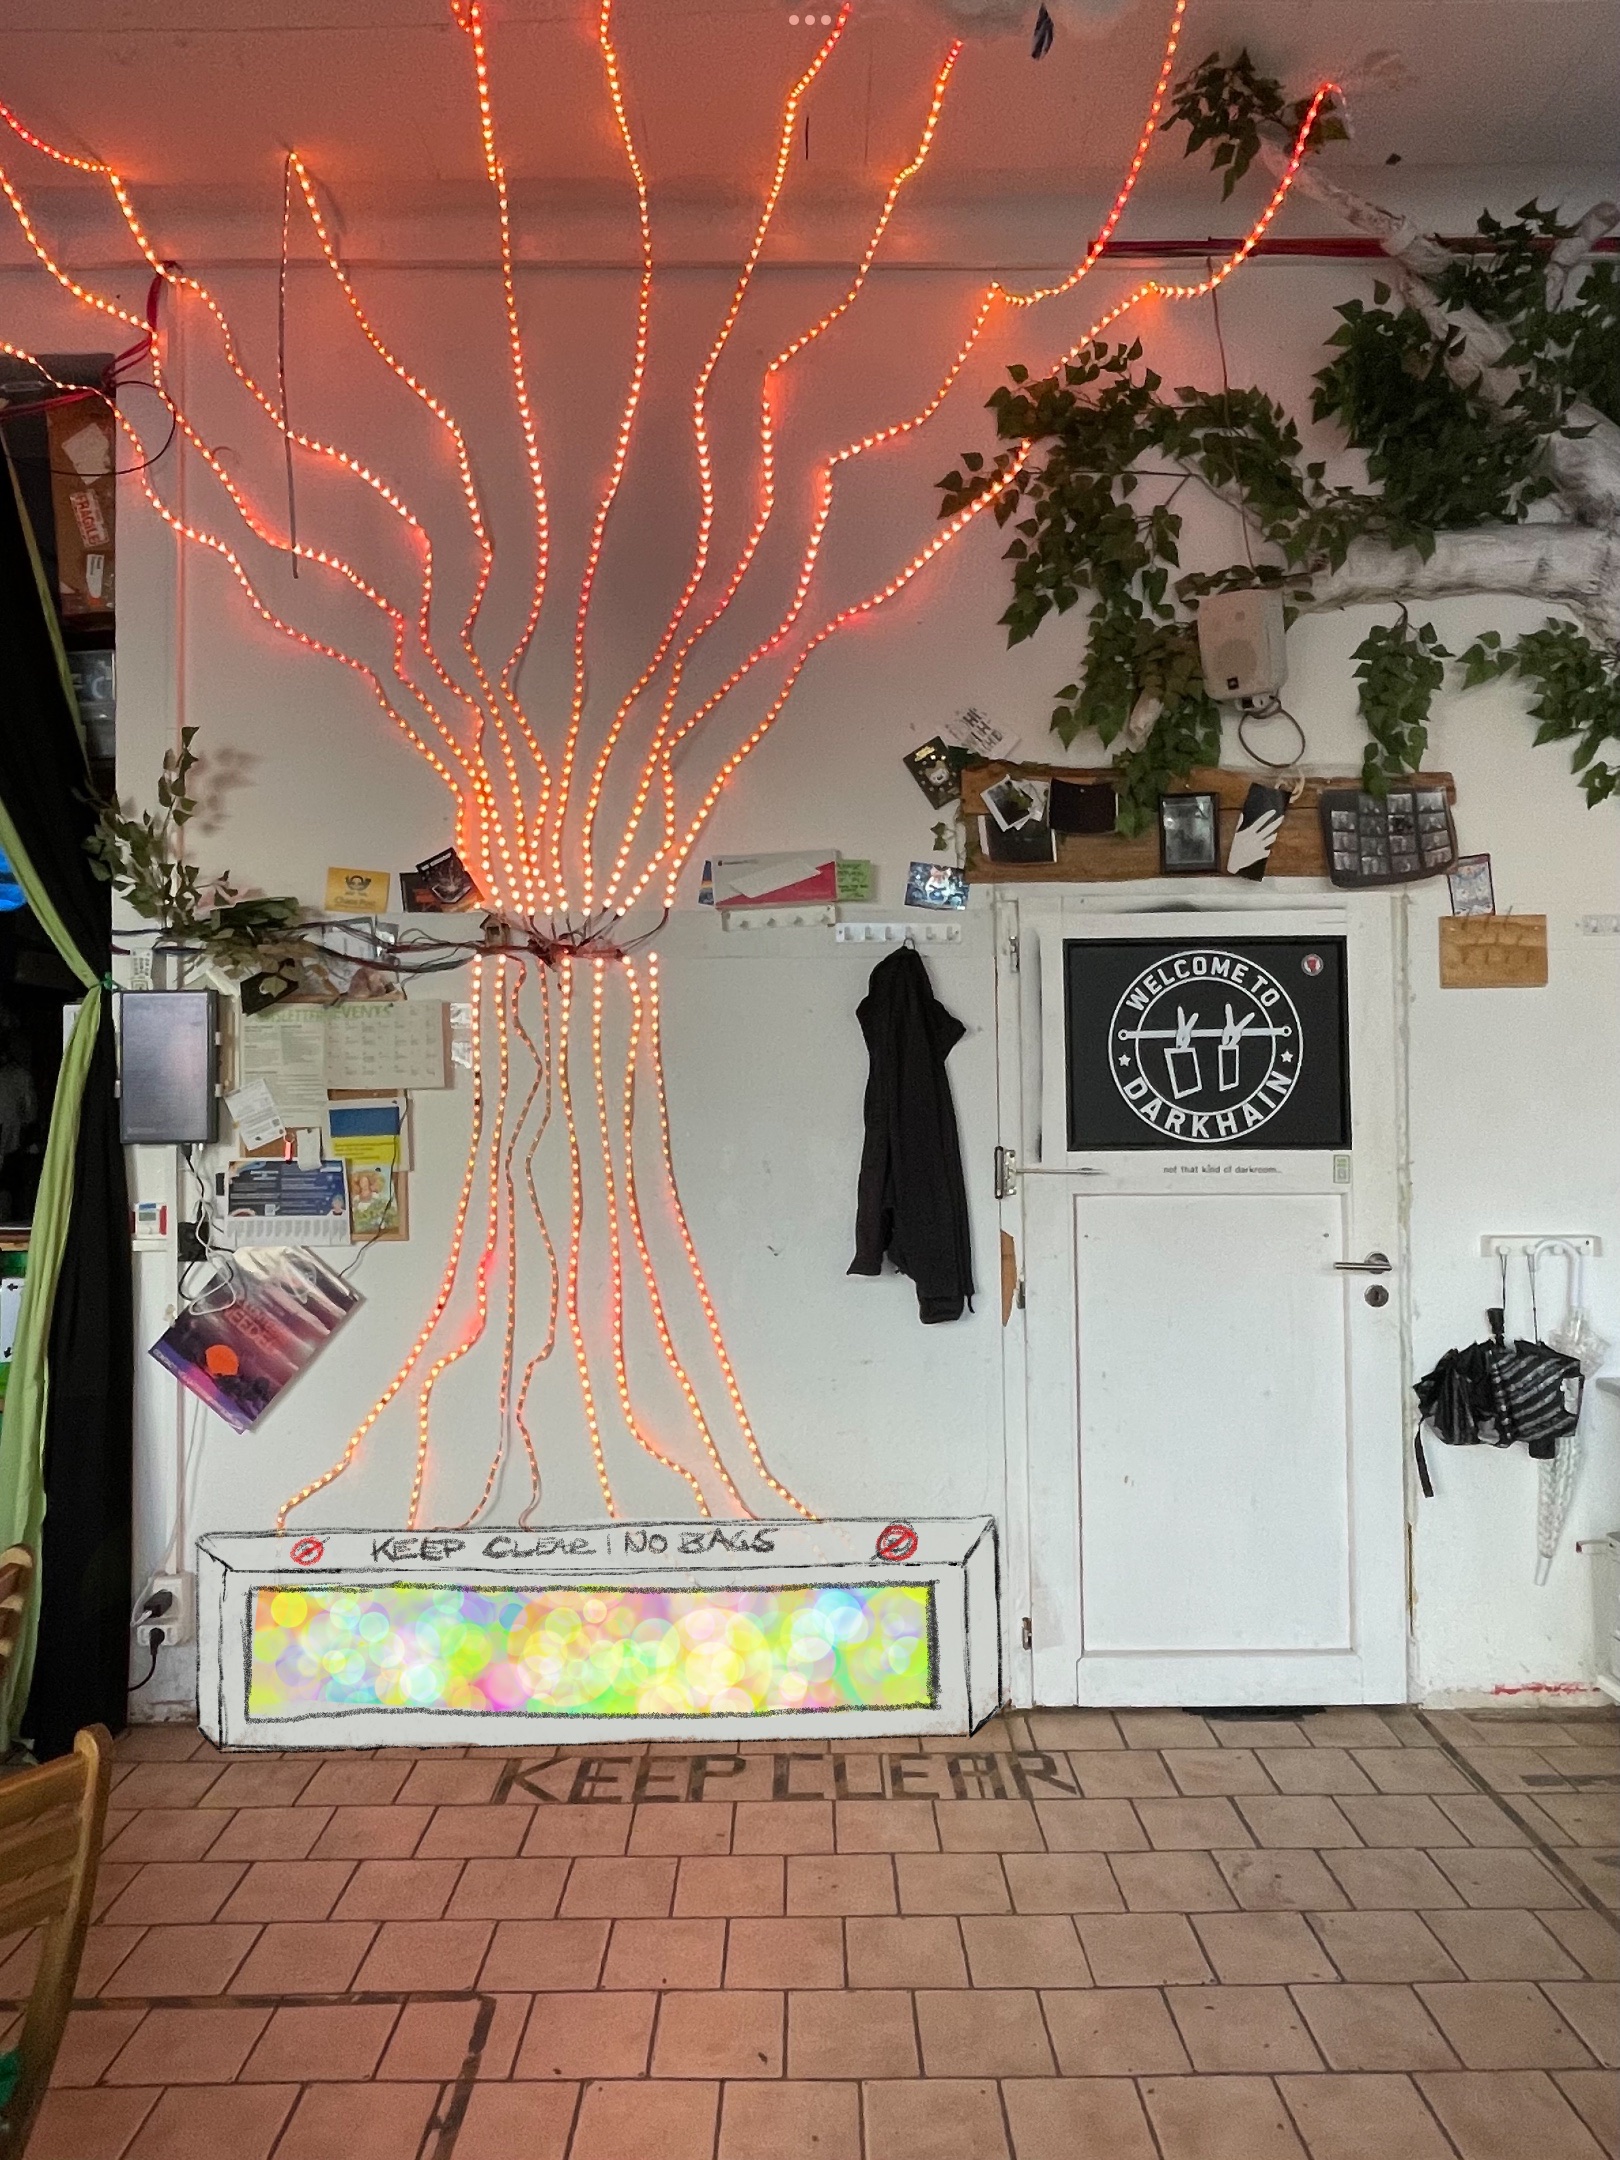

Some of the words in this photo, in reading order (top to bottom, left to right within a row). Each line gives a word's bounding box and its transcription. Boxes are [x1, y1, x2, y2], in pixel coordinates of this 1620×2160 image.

[1125, 956, 1249, 1011] WELCOME
[1250, 974, 1281, 1007] TO
[1123, 1070, 1293, 1139] DARKHAIN
[1163, 1165, 1177, 1173] not
[1181, 1165, 1198, 1173] that
[1202, 1164, 1221, 1173] kind
[1223, 1165, 1232, 1173] of
[371, 1536, 466, 1562] KEEP
[481, 1535, 597, 1560] CLEAR
[624, 1529, 668, 1556] NO
[676, 1527, 780, 1555] BAGS
[496, 1752, 747, 1804] KEEP
[770, 1751, 1078, 1802] CLEAR
